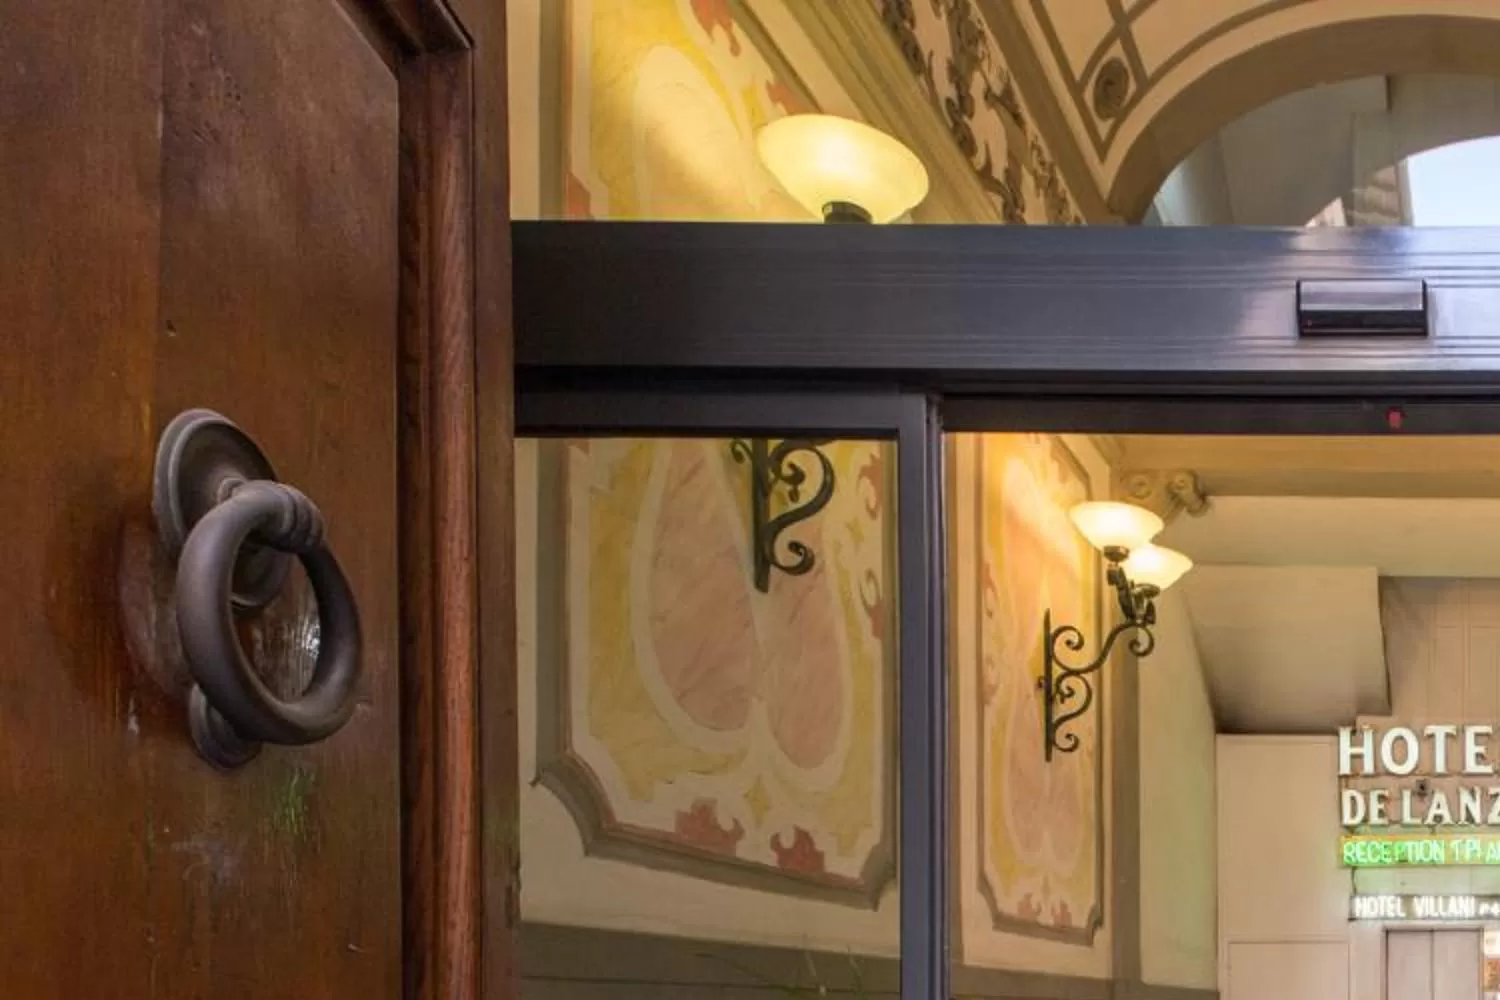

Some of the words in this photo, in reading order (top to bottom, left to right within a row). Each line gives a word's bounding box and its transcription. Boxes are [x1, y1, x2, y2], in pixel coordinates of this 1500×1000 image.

[1341, 787, 1389, 826] DE
[1343, 840, 1445, 864] RECEPTION
[1354, 895, 1407, 918] HOTEL
[1412, 895, 1476, 918] VILLANI
